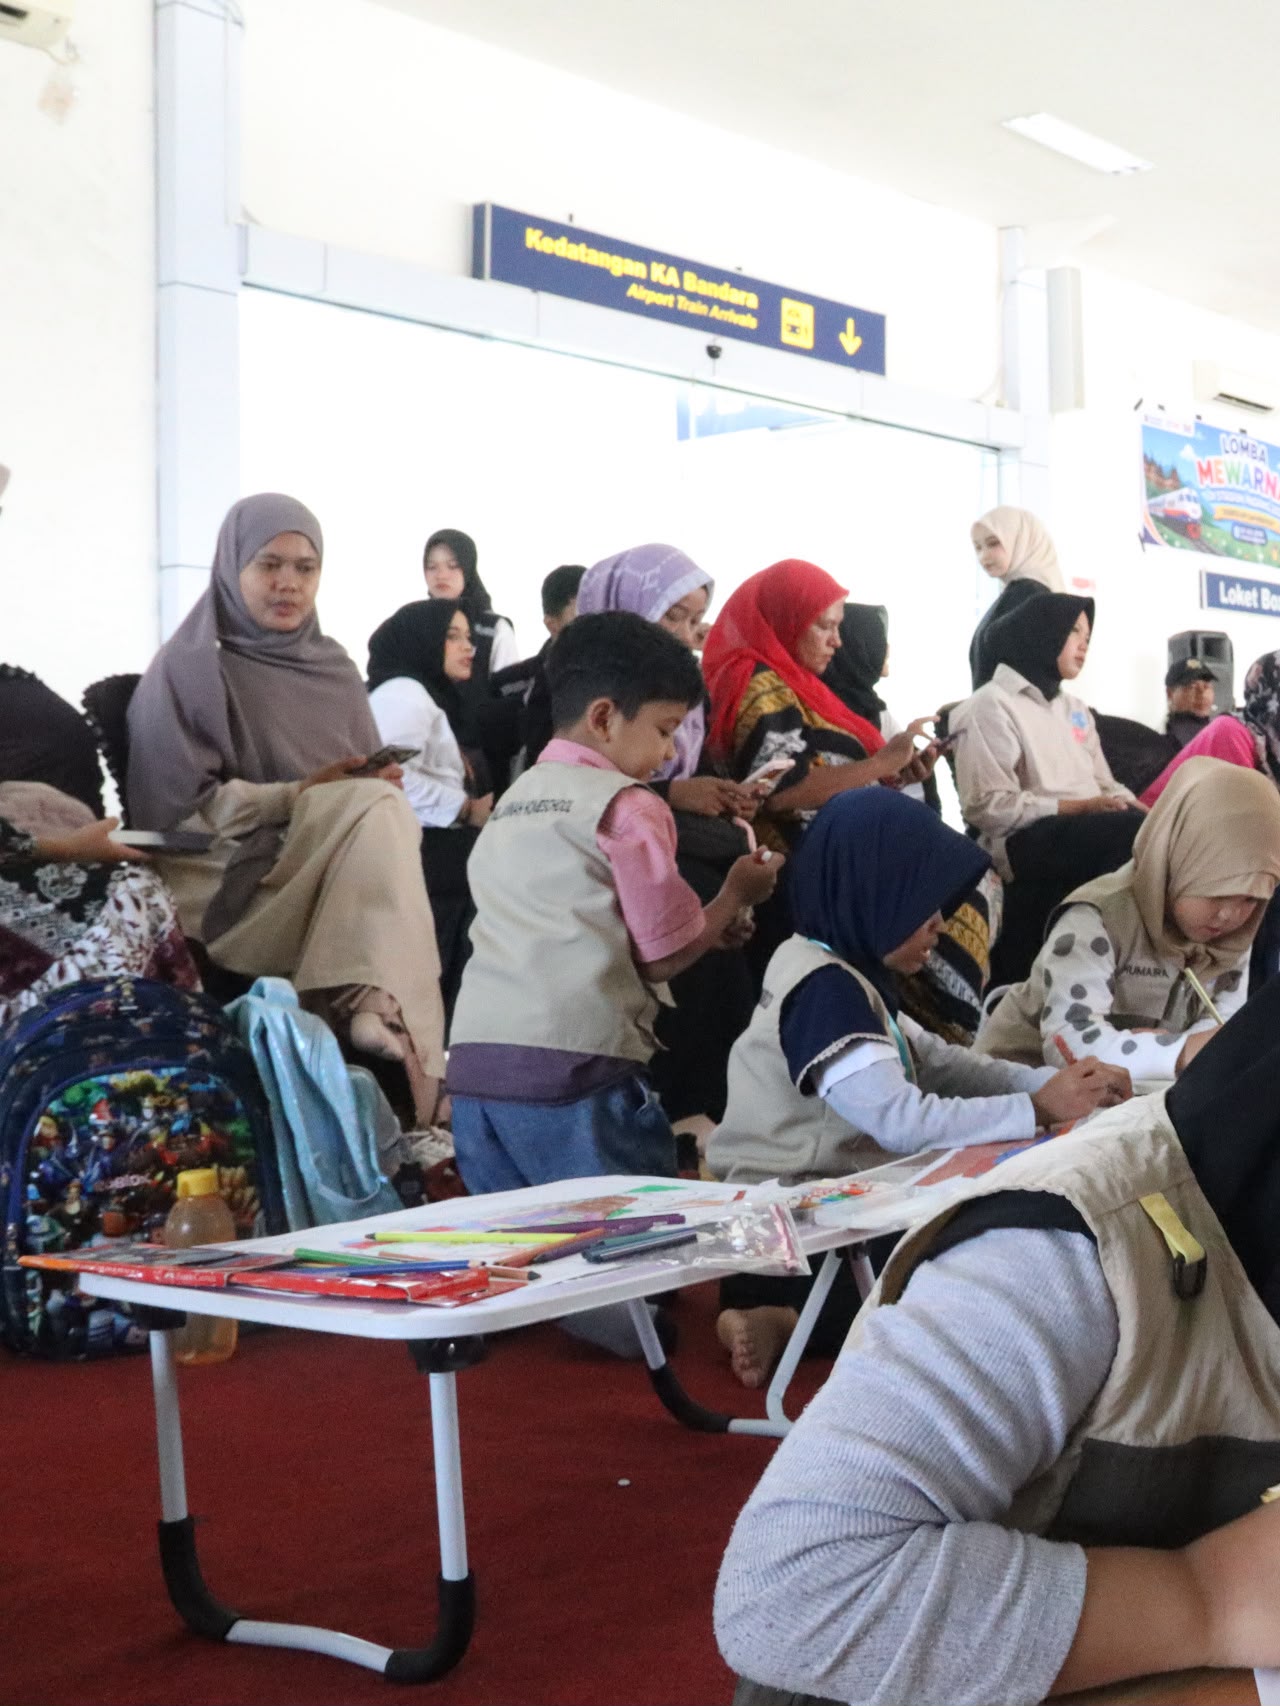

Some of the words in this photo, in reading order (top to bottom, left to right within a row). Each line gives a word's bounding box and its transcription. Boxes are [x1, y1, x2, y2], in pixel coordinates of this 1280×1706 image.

[525, 227, 647, 279] Kedatangan
[651, 261, 680, 288] KA
[683, 271, 759, 309] Bandara
[626, 283, 675, 307] Airport
[677, 295, 709, 315] Train
[709, 304, 758, 329] Arrivals
[1223, 438, 1266, 463] LOMBA
[1219, 580, 1258, 609] Loket
